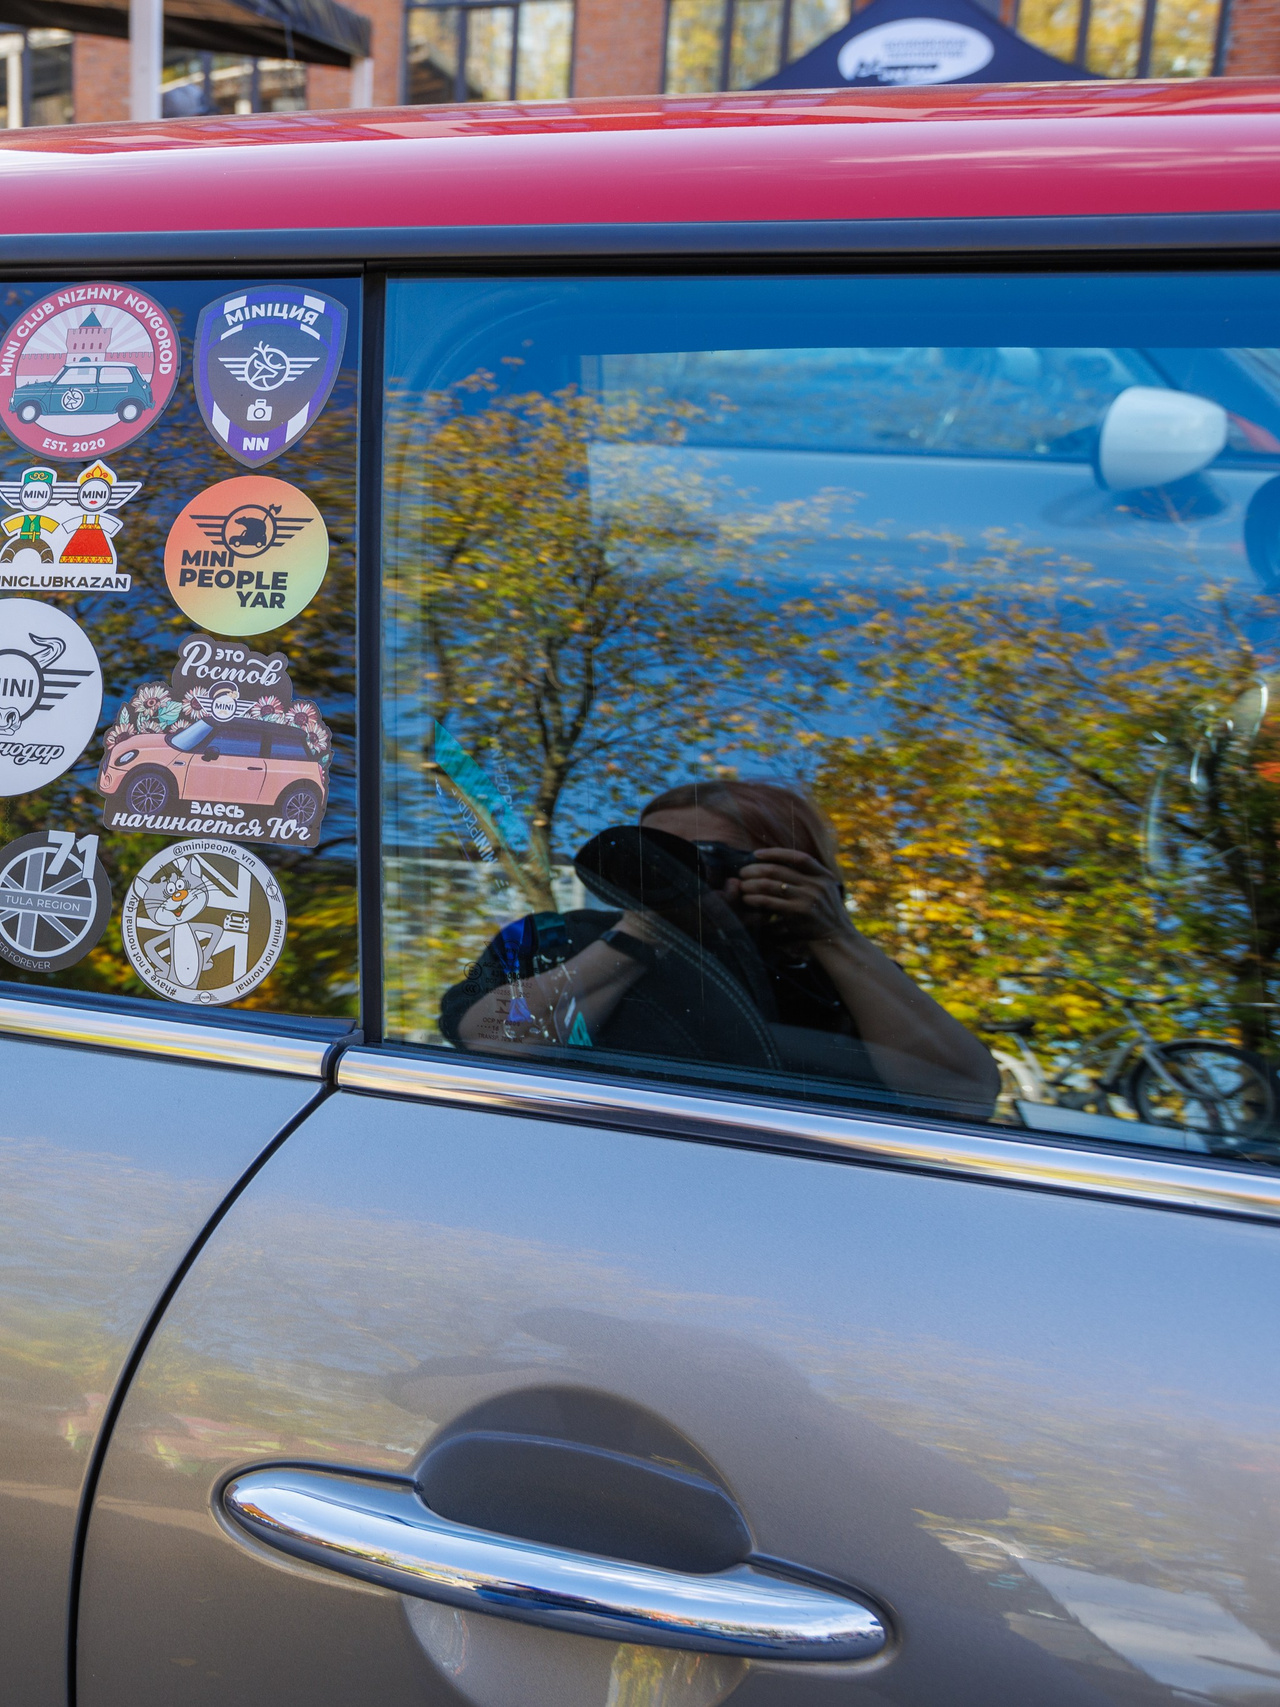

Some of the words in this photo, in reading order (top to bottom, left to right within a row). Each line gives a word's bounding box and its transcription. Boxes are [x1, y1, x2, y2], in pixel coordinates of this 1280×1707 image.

[0, 340, 21, 377] MINI
[17, 302, 55, 338] CLUB
[57, 287, 124, 307] NIZHNY
[124, 293, 173, 375] NOVGOROD
[42, 437, 68, 453] EST.
[72, 437, 106, 453] 2020
[242, 437, 269, 451] NN
[23, 490, 49, 499] MINI
[81, 490, 107, 499] MINI
[181, 549, 235, 568] MINI
[179, 568, 289, 591] PEOPLE
[236, 591, 286, 609] YAR
[181, 640, 283, 687] Ростов
[214, 702, 235, 712] MINI
[111, 811, 265, 837] начинается
[269, 817, 311, 841] Юг
[46, 829, 100, 880] 71
[173, 840, 257, 868] @minipeople_vrn
[5, 894, 34, 907] TULA
[37, 898, 81, 912] REGION
[125, 894, 140, 913] day
[125, 916, 138, 951] normal
[271, 918, 284, 948] #mini
[8, 951, 51, 970] FOREVER
[133, 953, 146, 969] not
[263, 949, 276, 967] not
[150, 974, 178, 997] #have
[235, 966, 265, 995] normal
